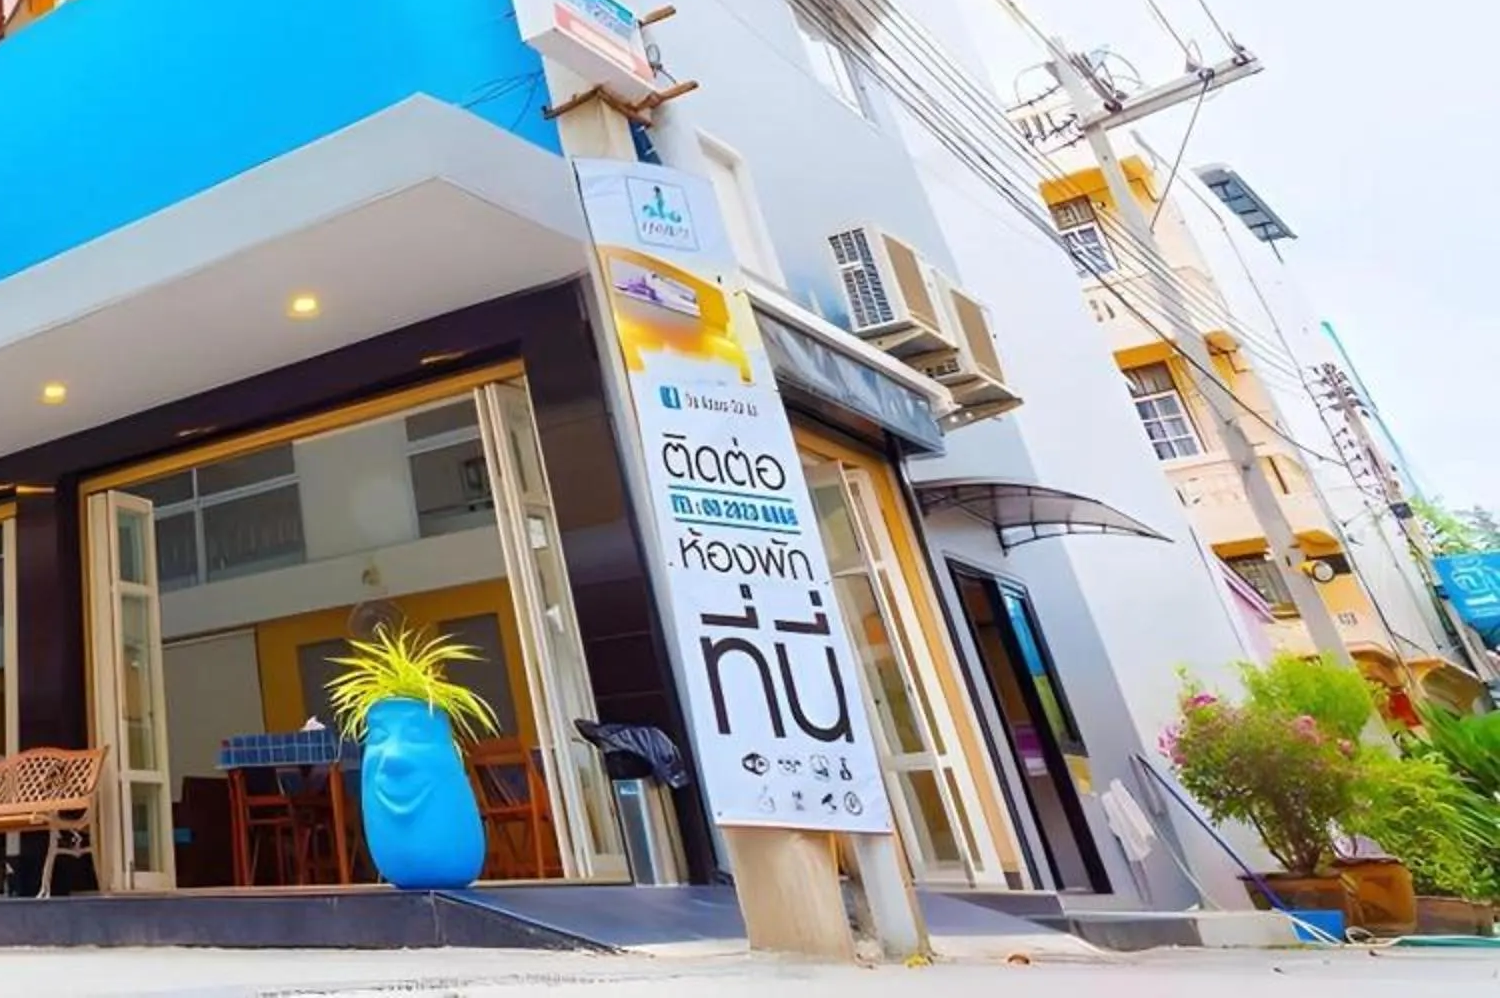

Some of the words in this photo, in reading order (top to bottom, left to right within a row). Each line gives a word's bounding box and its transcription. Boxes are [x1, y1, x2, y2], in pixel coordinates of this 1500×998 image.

[662, 433, 786, 491] ติดต่อ
[679, 528, 815, 582] ห้องพัก
